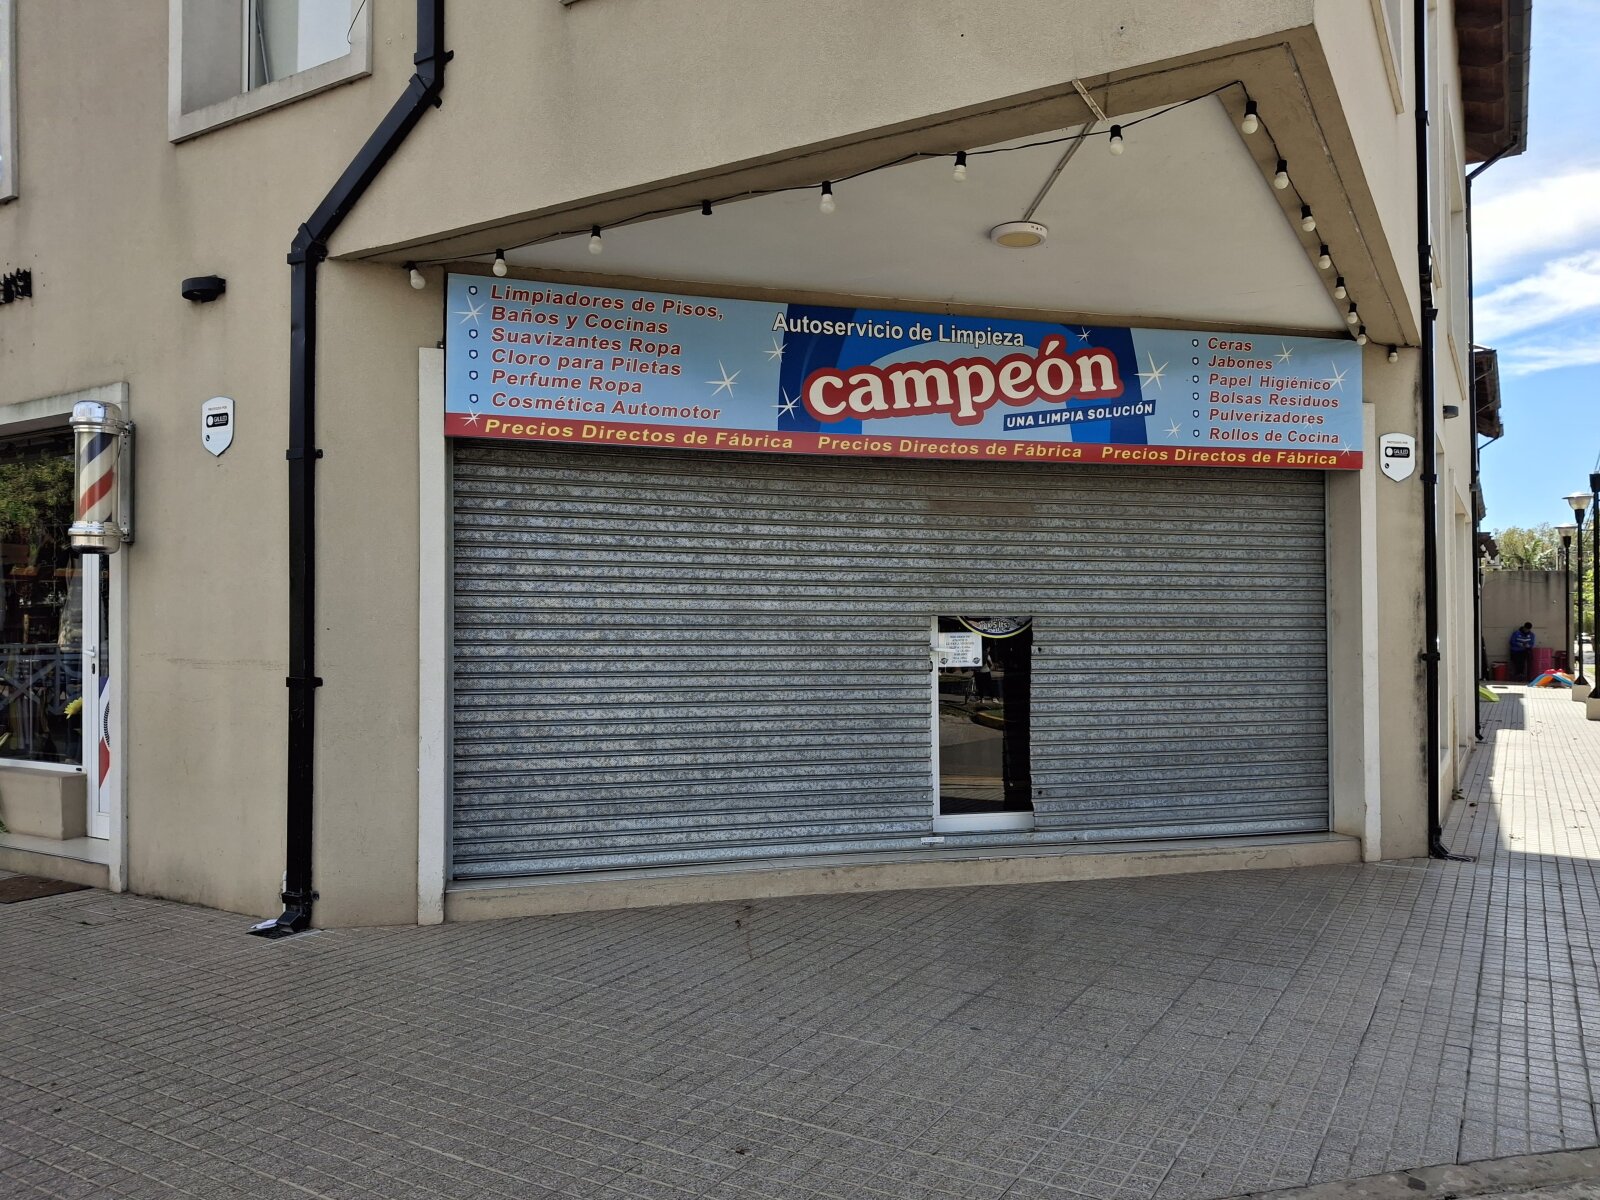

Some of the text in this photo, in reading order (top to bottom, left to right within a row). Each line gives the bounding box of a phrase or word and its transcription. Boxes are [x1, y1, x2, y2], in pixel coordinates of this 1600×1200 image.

[490, 285, 724, 321] Limpiadores de Pisos,
[490, 306, 669, 334] Baños y Cocinas
[772, 312, 1024, 349] Autoservicio de Limpieza
[491, 328, 681, 357] Suavizantes Ropa
[1208, 338, 1252, 352] Ceras
[491, 349, 681, 376] Cloro para Piletas
[1208, 356, 1273, 370] Jabones
[491, 370, 642, 396] Perfume Ropa
[808, 340, 1117, 418] campeón
[1208, 374, 1331, 392] Papel Higiénico
[492, 392, 721, 420] Cosmética Automotor
[1209, 392, 1339, 409] Bolsas Residuos
[1006, 403, 1153, 428] UNA LIMPIA SOLUCIÓN
[1209, 410, 1324, 425] Pulverizadores
[485, 419, 794, 450] Precios Directos de Fábrica
[1209, 428, 1339, 444] Rollos de Cocina
[818, 436, 1082, 459] Precios Directos de Fábrica
[1102, 447, 1337, 465] Precios Directos de Fábrica
